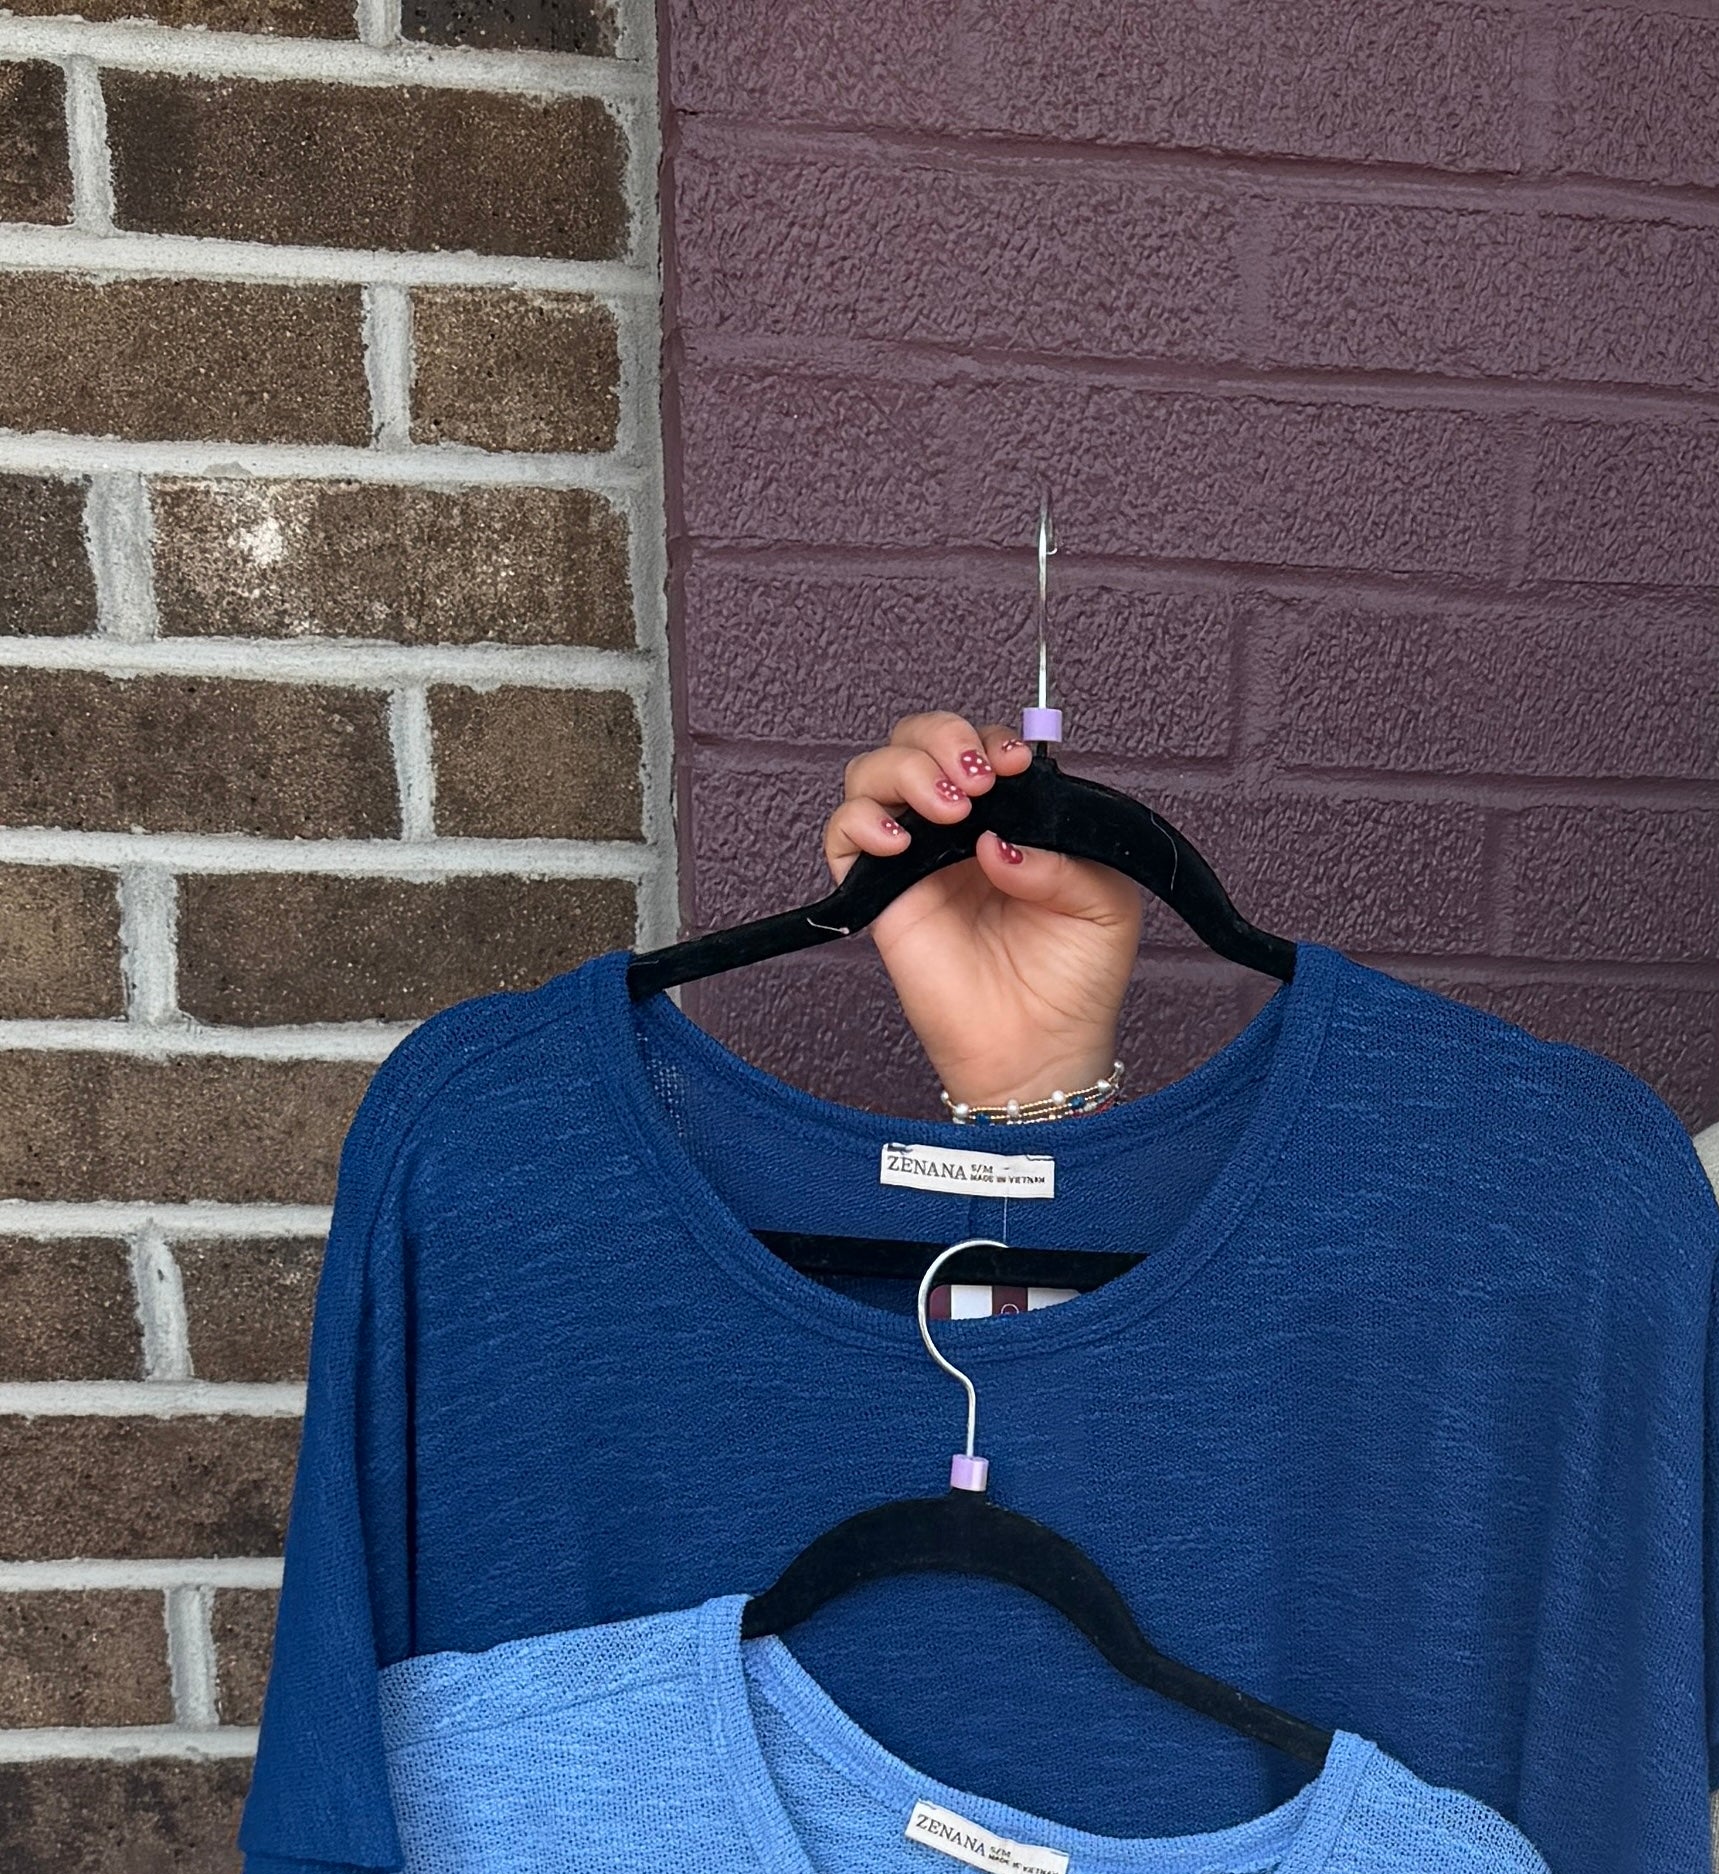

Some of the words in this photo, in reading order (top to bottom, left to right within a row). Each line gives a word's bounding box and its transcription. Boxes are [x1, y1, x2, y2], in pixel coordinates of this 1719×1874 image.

[887, 1155, 967, 1181] ZENANA
[971, 1163, 994, 1174] S/M
[970, 1174, 994, 1183] MADE
[916, 1814, 985, 1857] ZENANA
